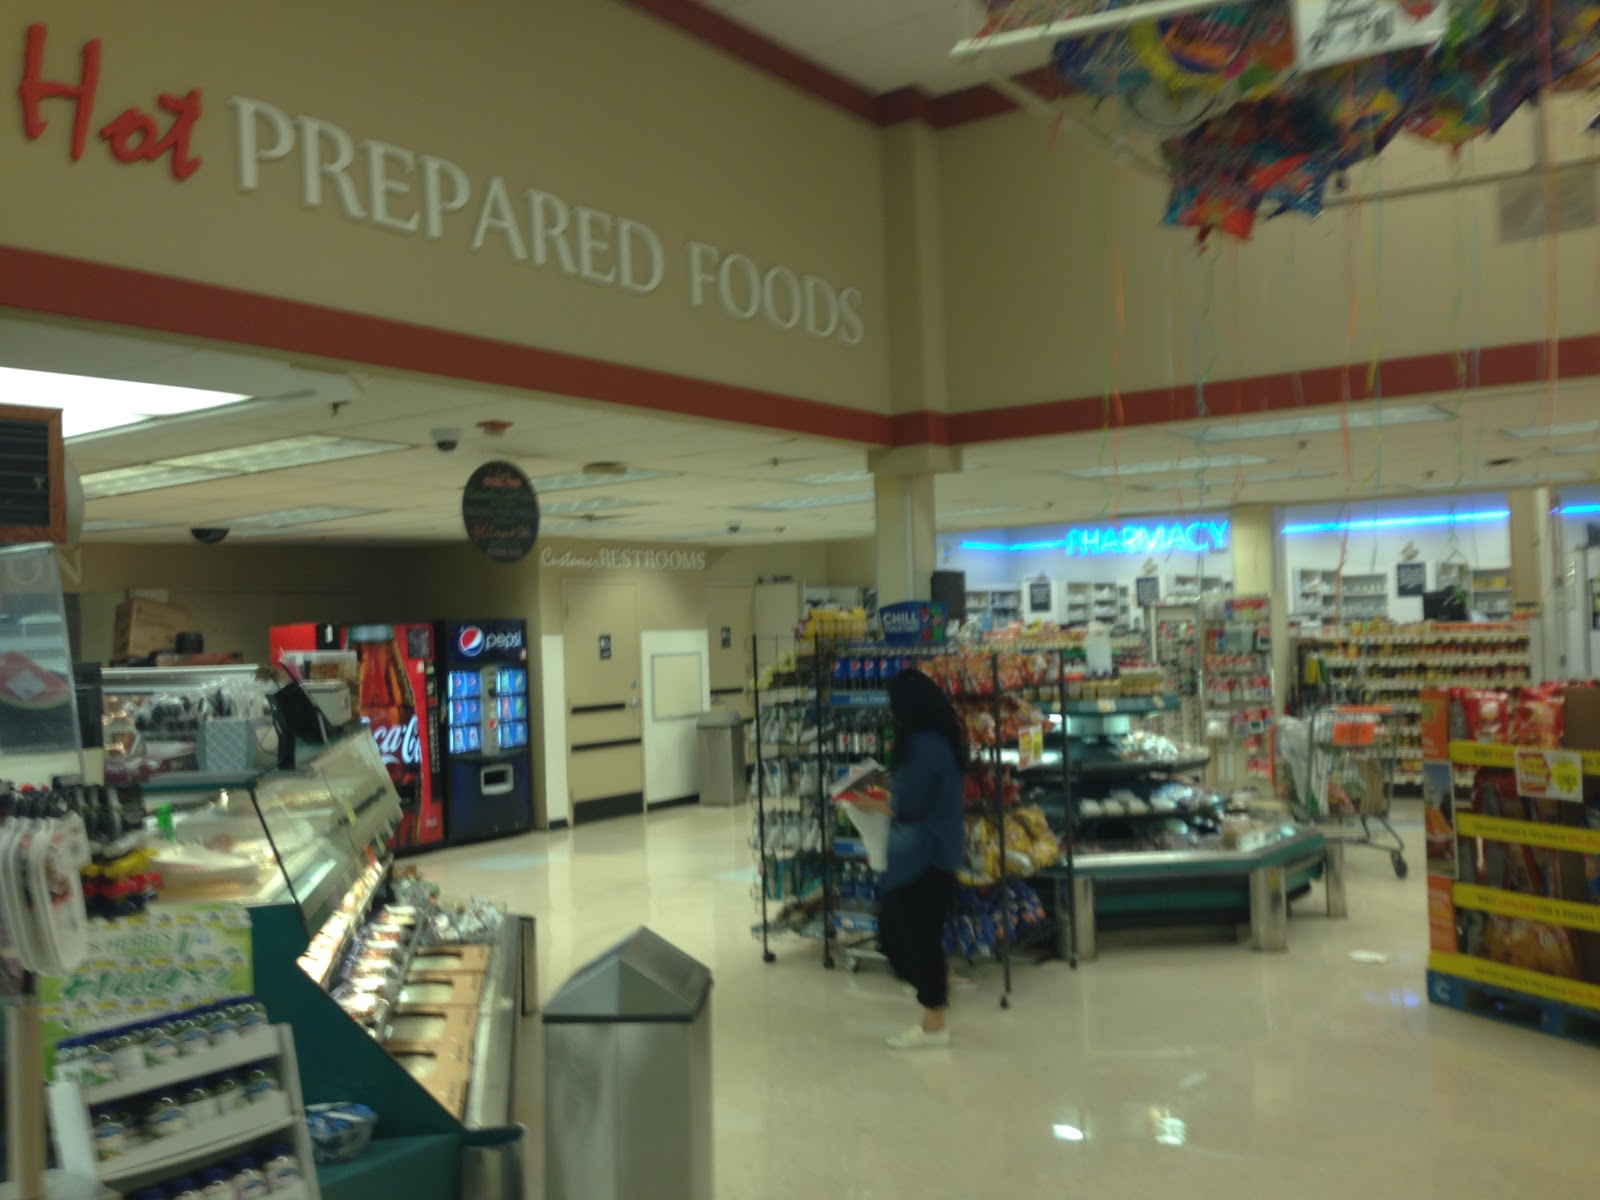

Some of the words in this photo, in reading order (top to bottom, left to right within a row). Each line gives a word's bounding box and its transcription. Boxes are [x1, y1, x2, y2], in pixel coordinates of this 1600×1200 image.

[17, 22, 204, 181] Hot
[228, 94, 665, 296] PREPARED
[687, 239, 865, 346] FOODS
[1065, 519, 1228, 555] PHARMACY
[539, 545, 600, 569] Customer
[600, 547, 706, 570] RESTROOMS
[883, 610, 919, 624] CHILL
[485, 630, 522, 651] pepsi
